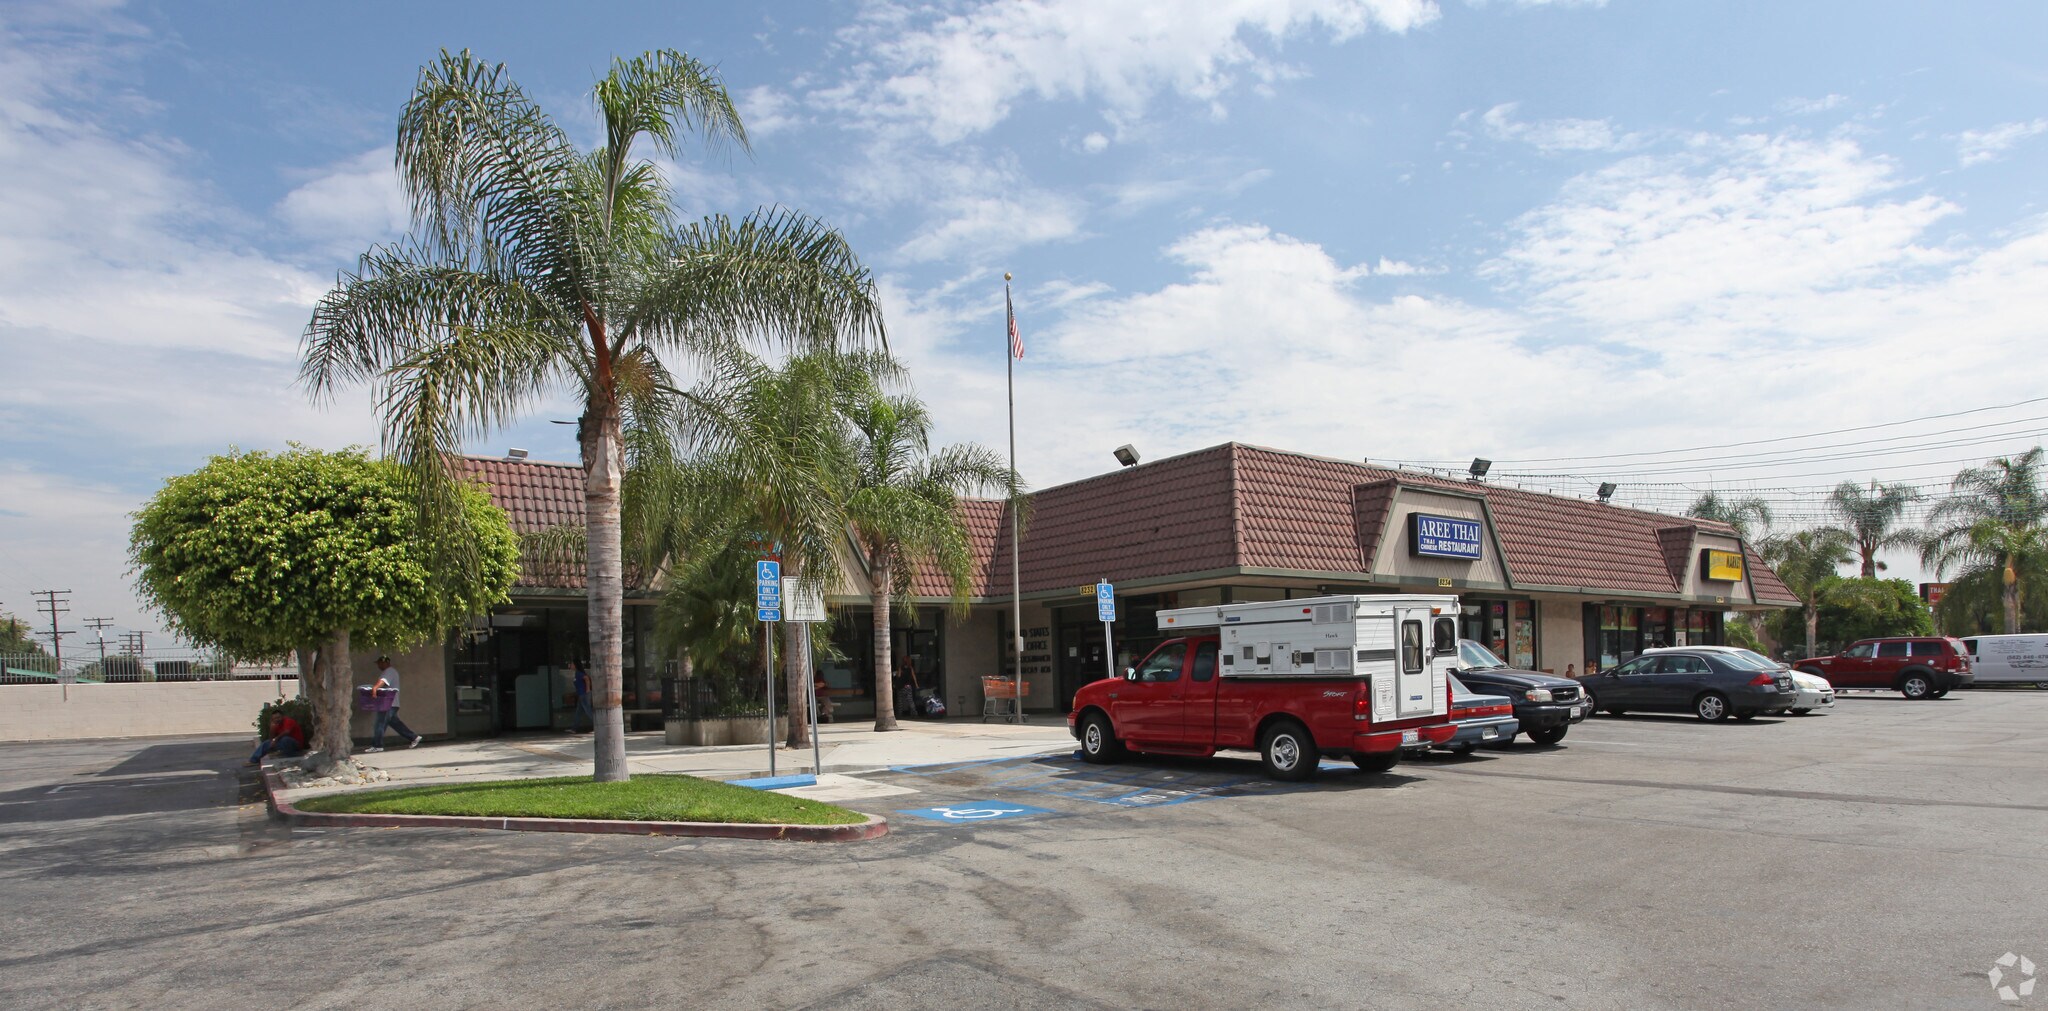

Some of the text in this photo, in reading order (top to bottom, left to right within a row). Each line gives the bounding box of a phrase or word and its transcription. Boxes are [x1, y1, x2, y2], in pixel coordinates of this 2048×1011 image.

[1421, 520, 1479, 541] AREE THAI
[1439, 541, 1479, 554] RESTAURANT
[1029, 627, 1050, 638] STATES
[1026, 640, 1049, 651] OFFICE
